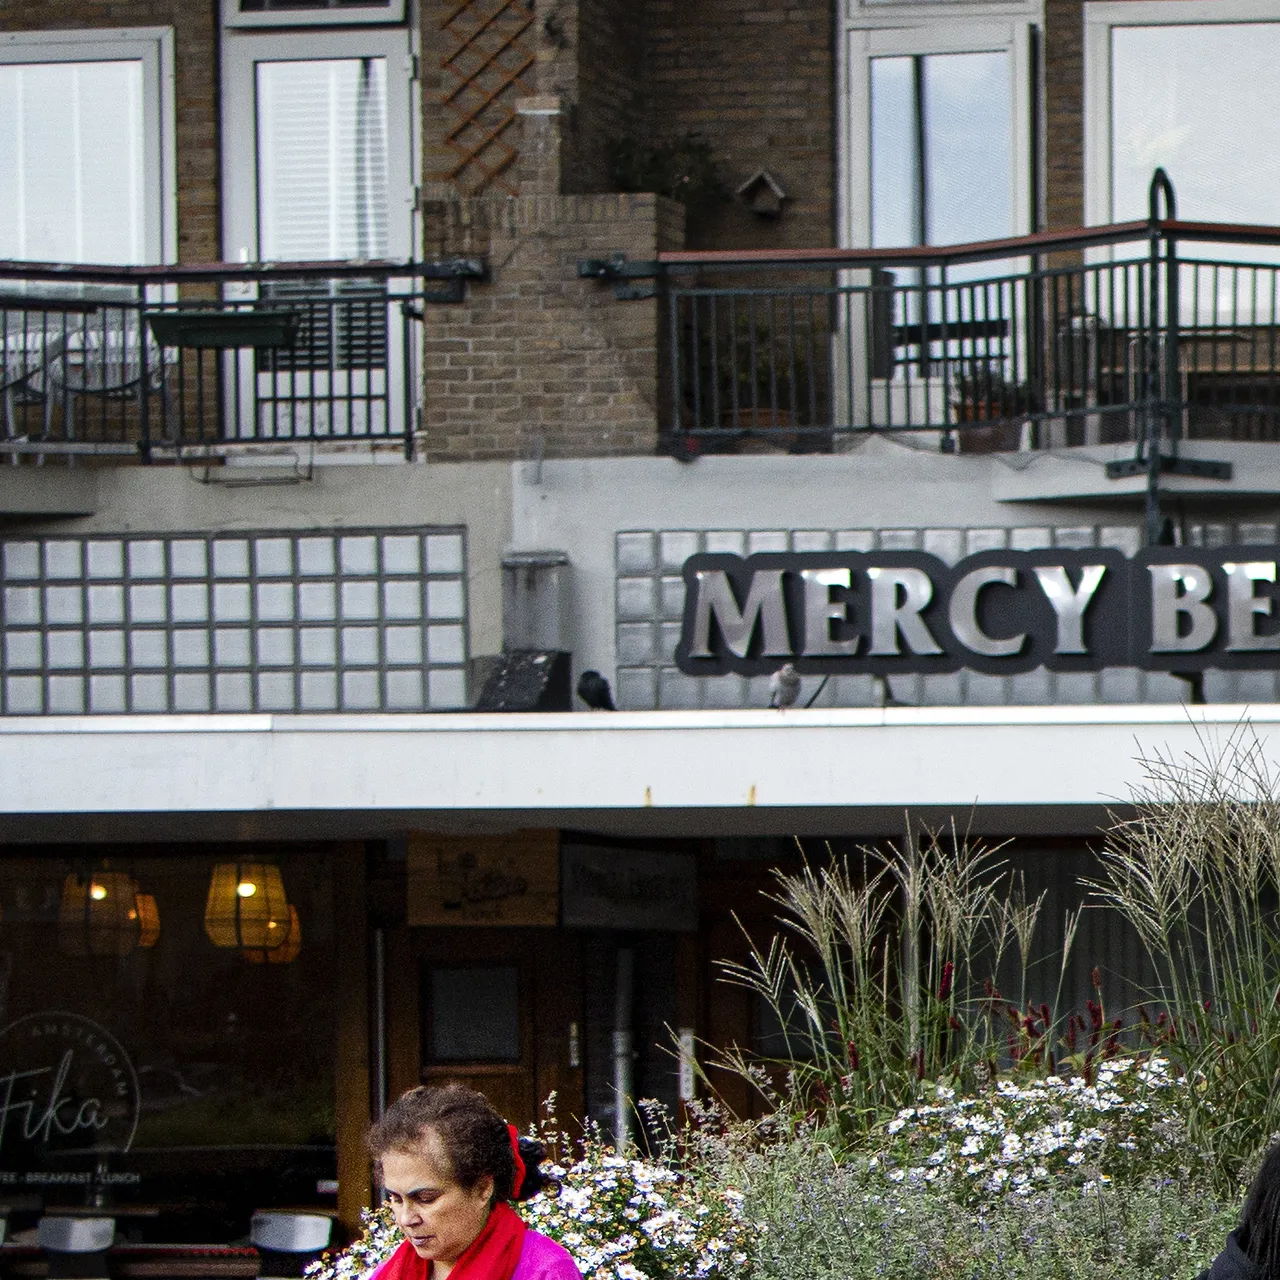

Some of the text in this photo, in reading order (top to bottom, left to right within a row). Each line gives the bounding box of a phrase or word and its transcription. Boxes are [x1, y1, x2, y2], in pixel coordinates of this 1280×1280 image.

[690, 564, 1105, 659] MERCY
[0, 1047, 110, 1155] Fika
[25, 1172, 92, 1185] BREAKFAST
[101, 1172, 141, 1185] LUNCH
